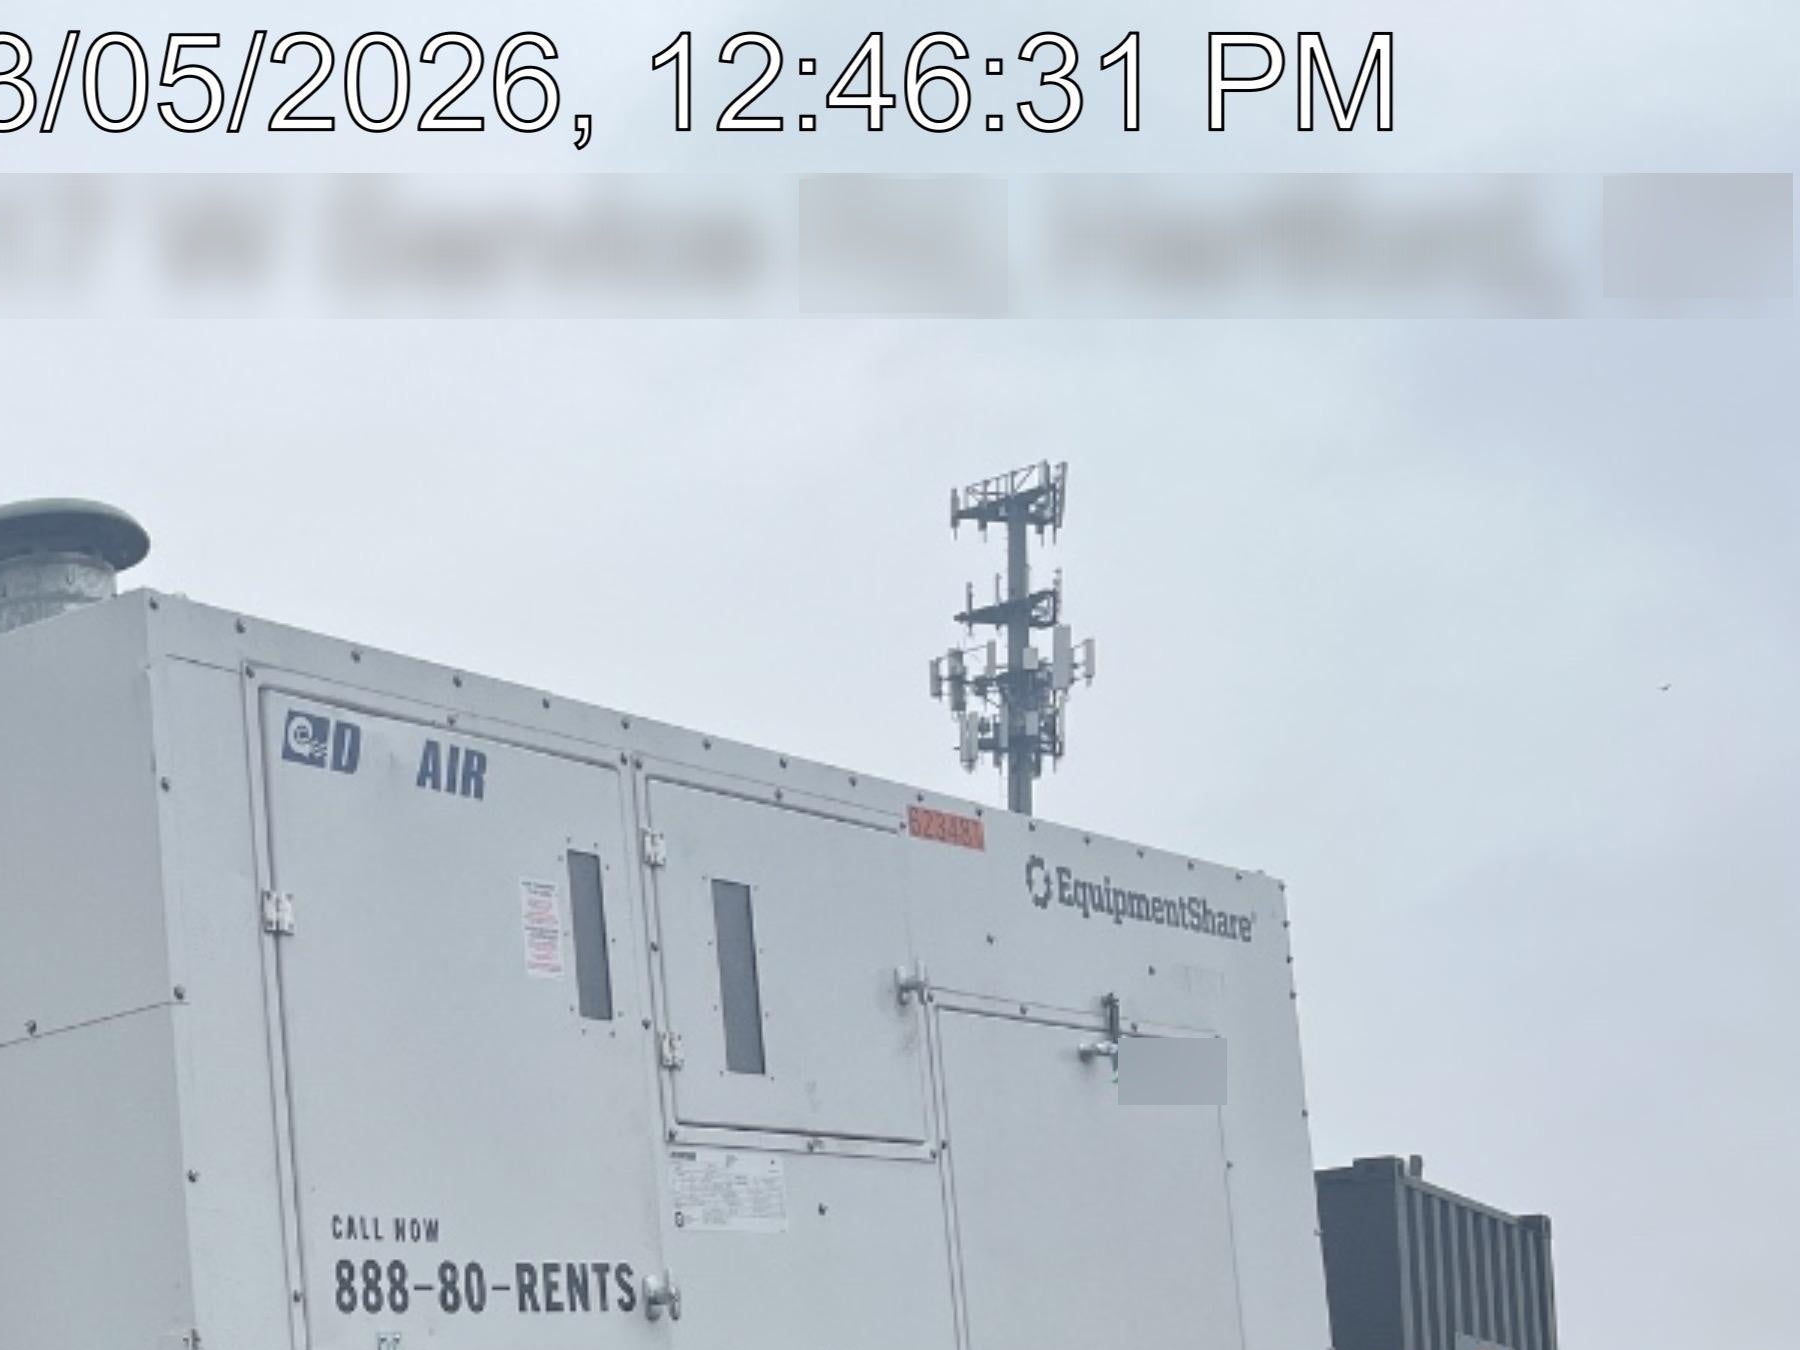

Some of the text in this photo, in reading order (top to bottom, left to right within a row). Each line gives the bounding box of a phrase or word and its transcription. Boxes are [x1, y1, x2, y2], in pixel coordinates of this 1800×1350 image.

[331, 1214, 440, 1243] CALL NOW
[334, 1259, 638, 1314] 888-80-RENTS
